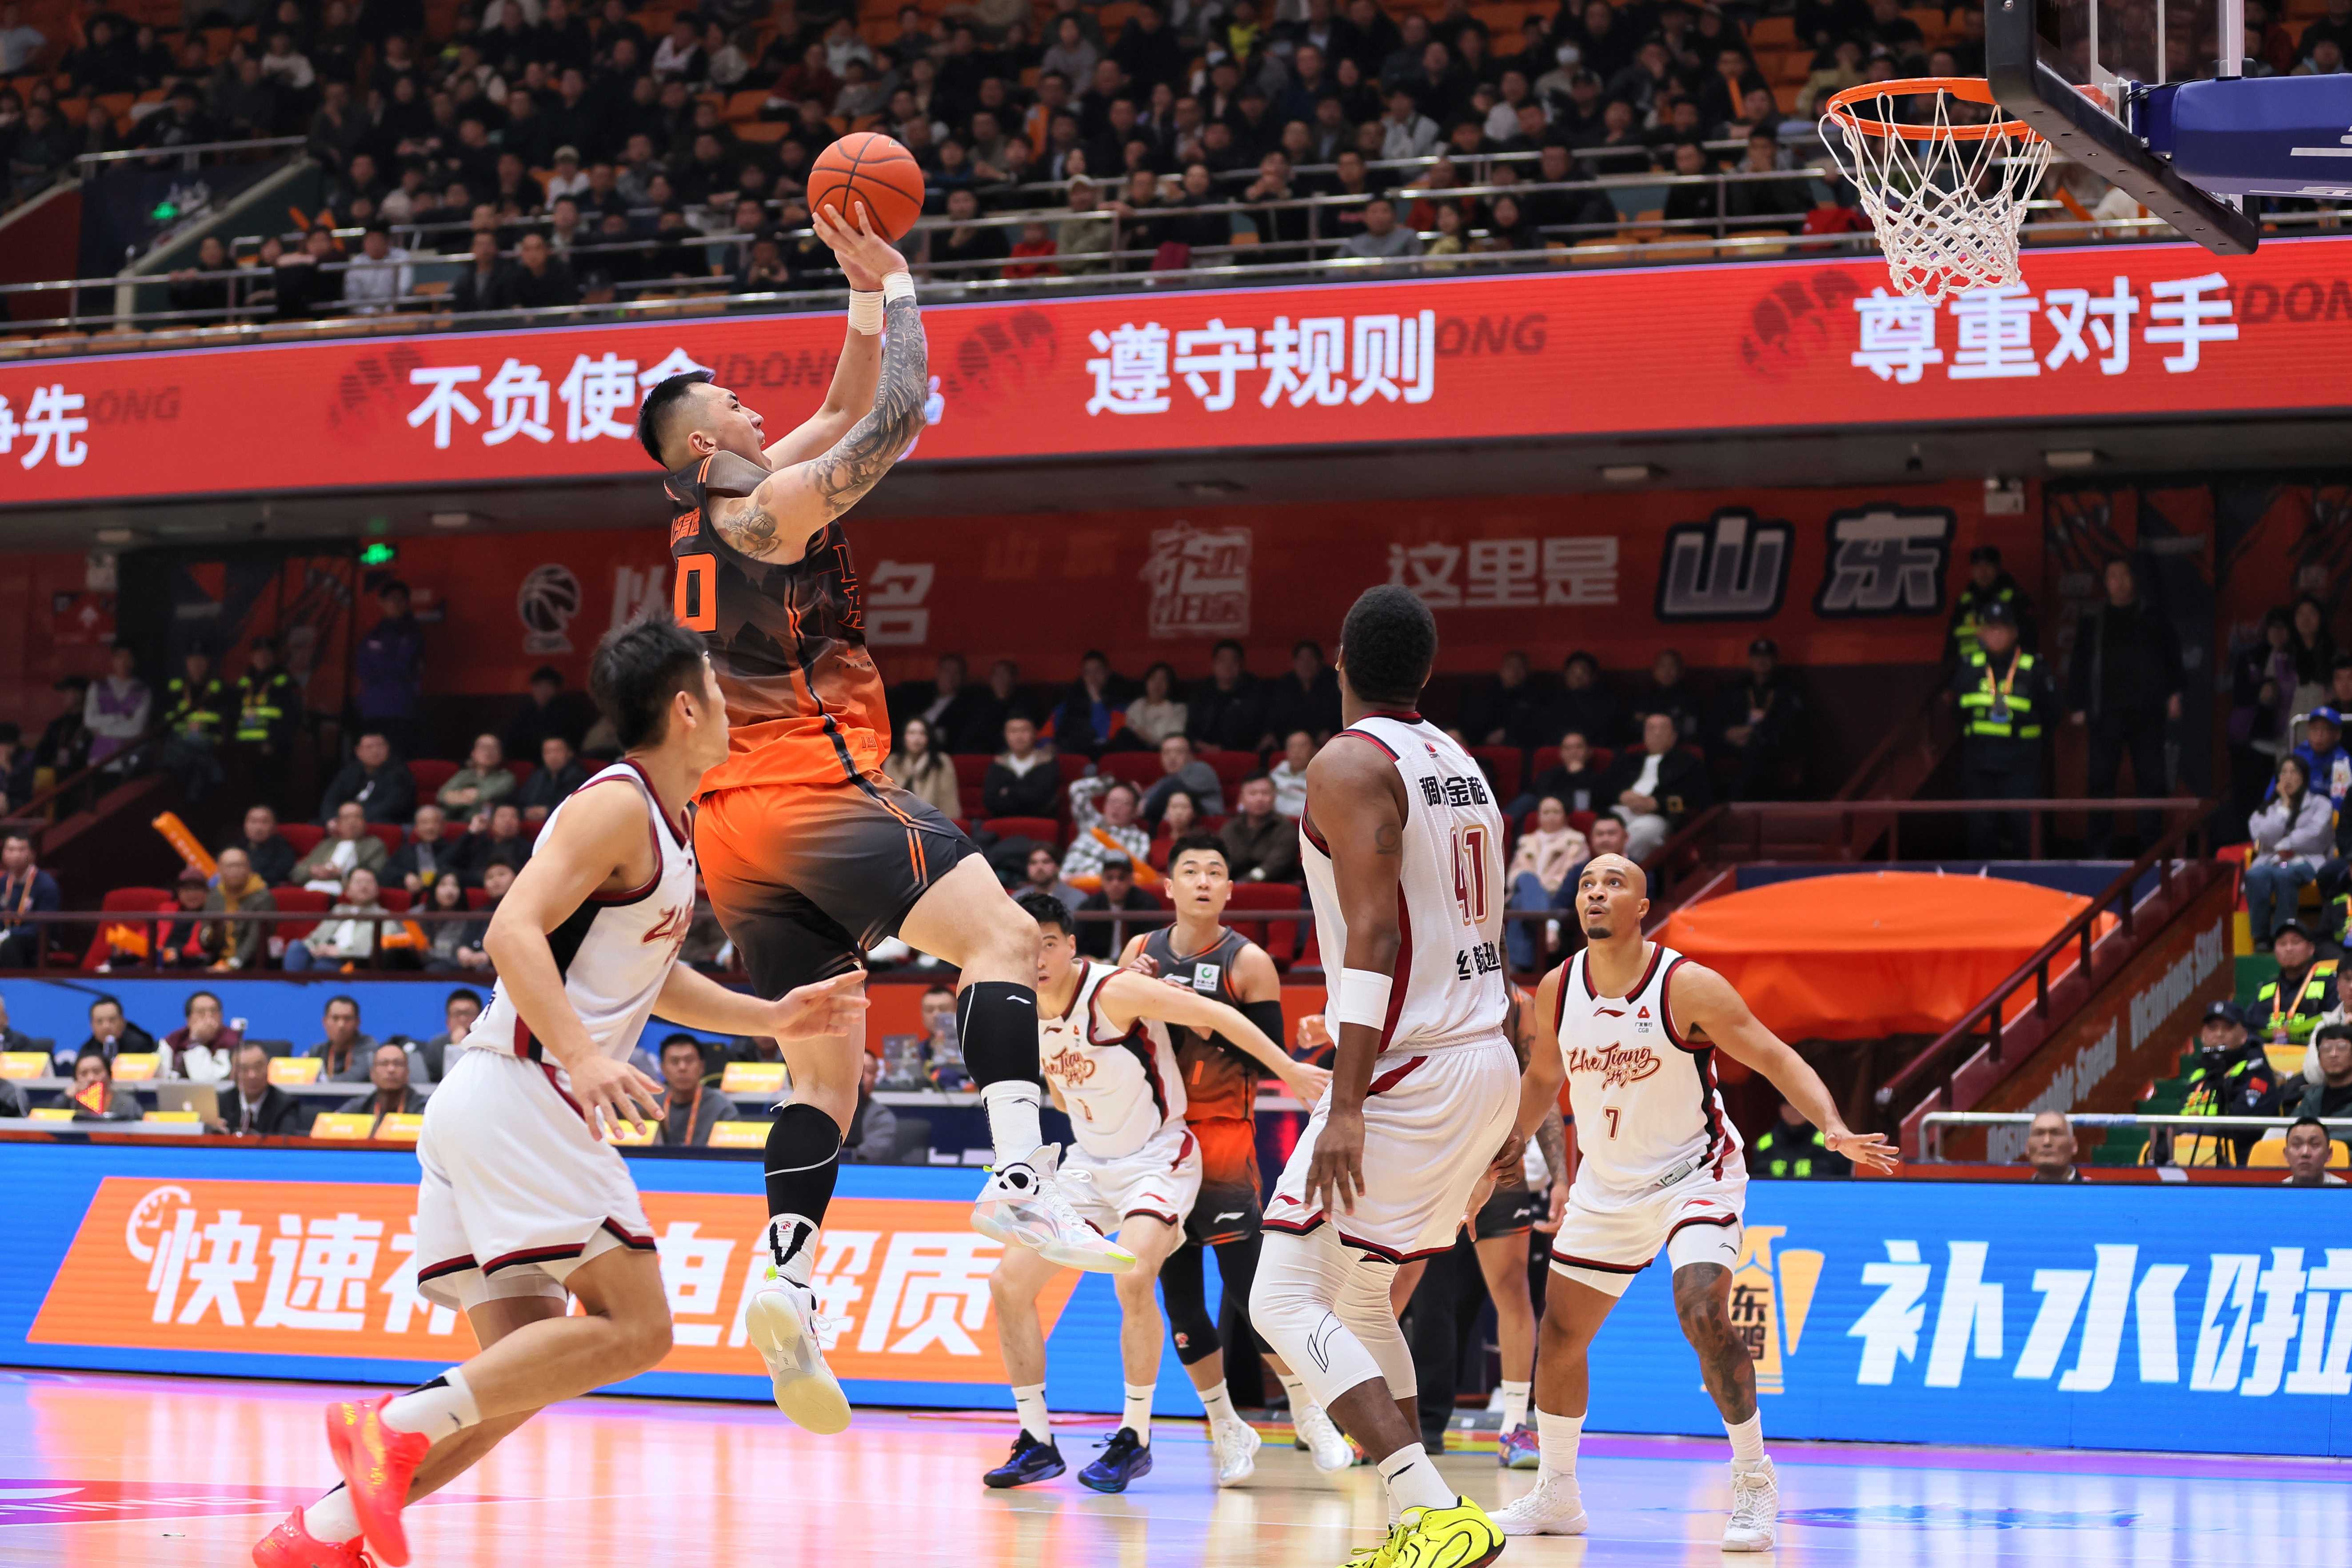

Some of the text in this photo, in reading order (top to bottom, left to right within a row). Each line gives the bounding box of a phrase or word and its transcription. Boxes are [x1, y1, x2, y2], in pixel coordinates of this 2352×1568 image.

[1086, 310, 1436, 415] 遵守规则
[1851, 272, 2239, 384] 尊重对手
[1386, 501, 1954, 621] 这里是 山东
[1450, 824, 1488, 926] 41
[1603, 1106, 1622, 1141] 7
[148, 1208, 1006, 1356] 快速电解质
[1848, 1240, 2352, 1397] 补水啦
